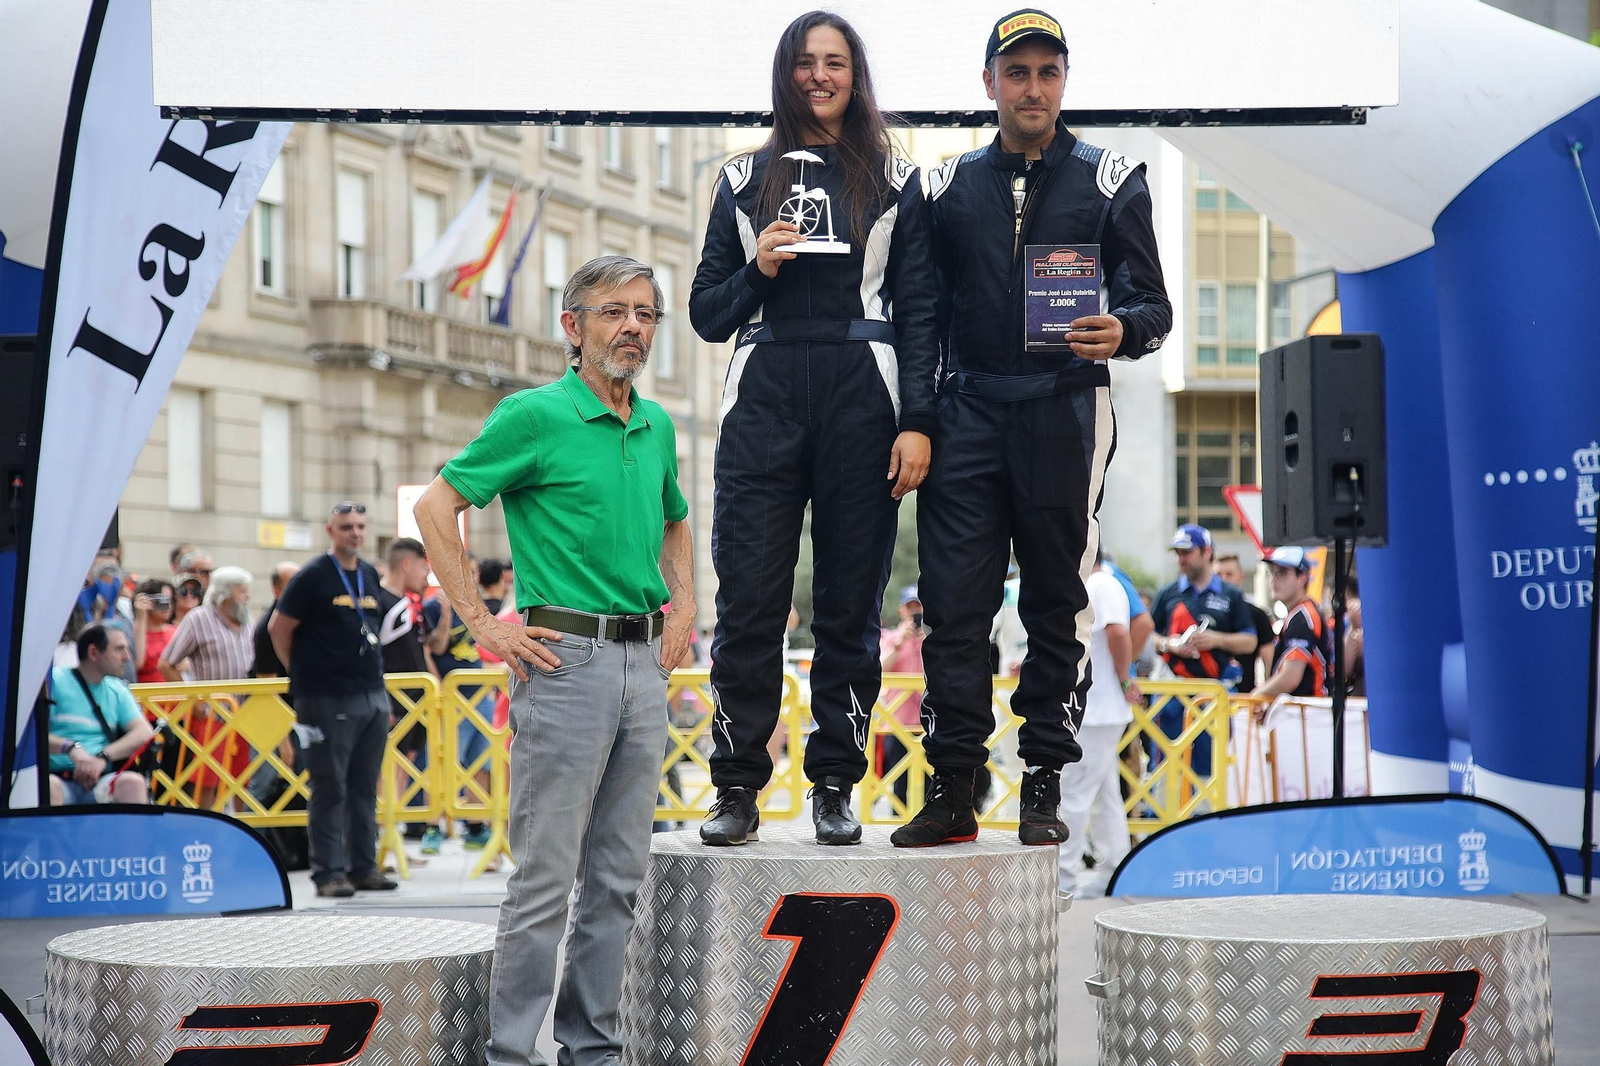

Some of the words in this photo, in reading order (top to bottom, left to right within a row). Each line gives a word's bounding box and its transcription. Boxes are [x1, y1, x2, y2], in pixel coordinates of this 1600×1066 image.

[1048, 252, 1078, 263] 59
[1050, 298, 1077, 307] 2.000€
[66, 222, 206, 395] La
[738, 891, 901, 1066] 1
